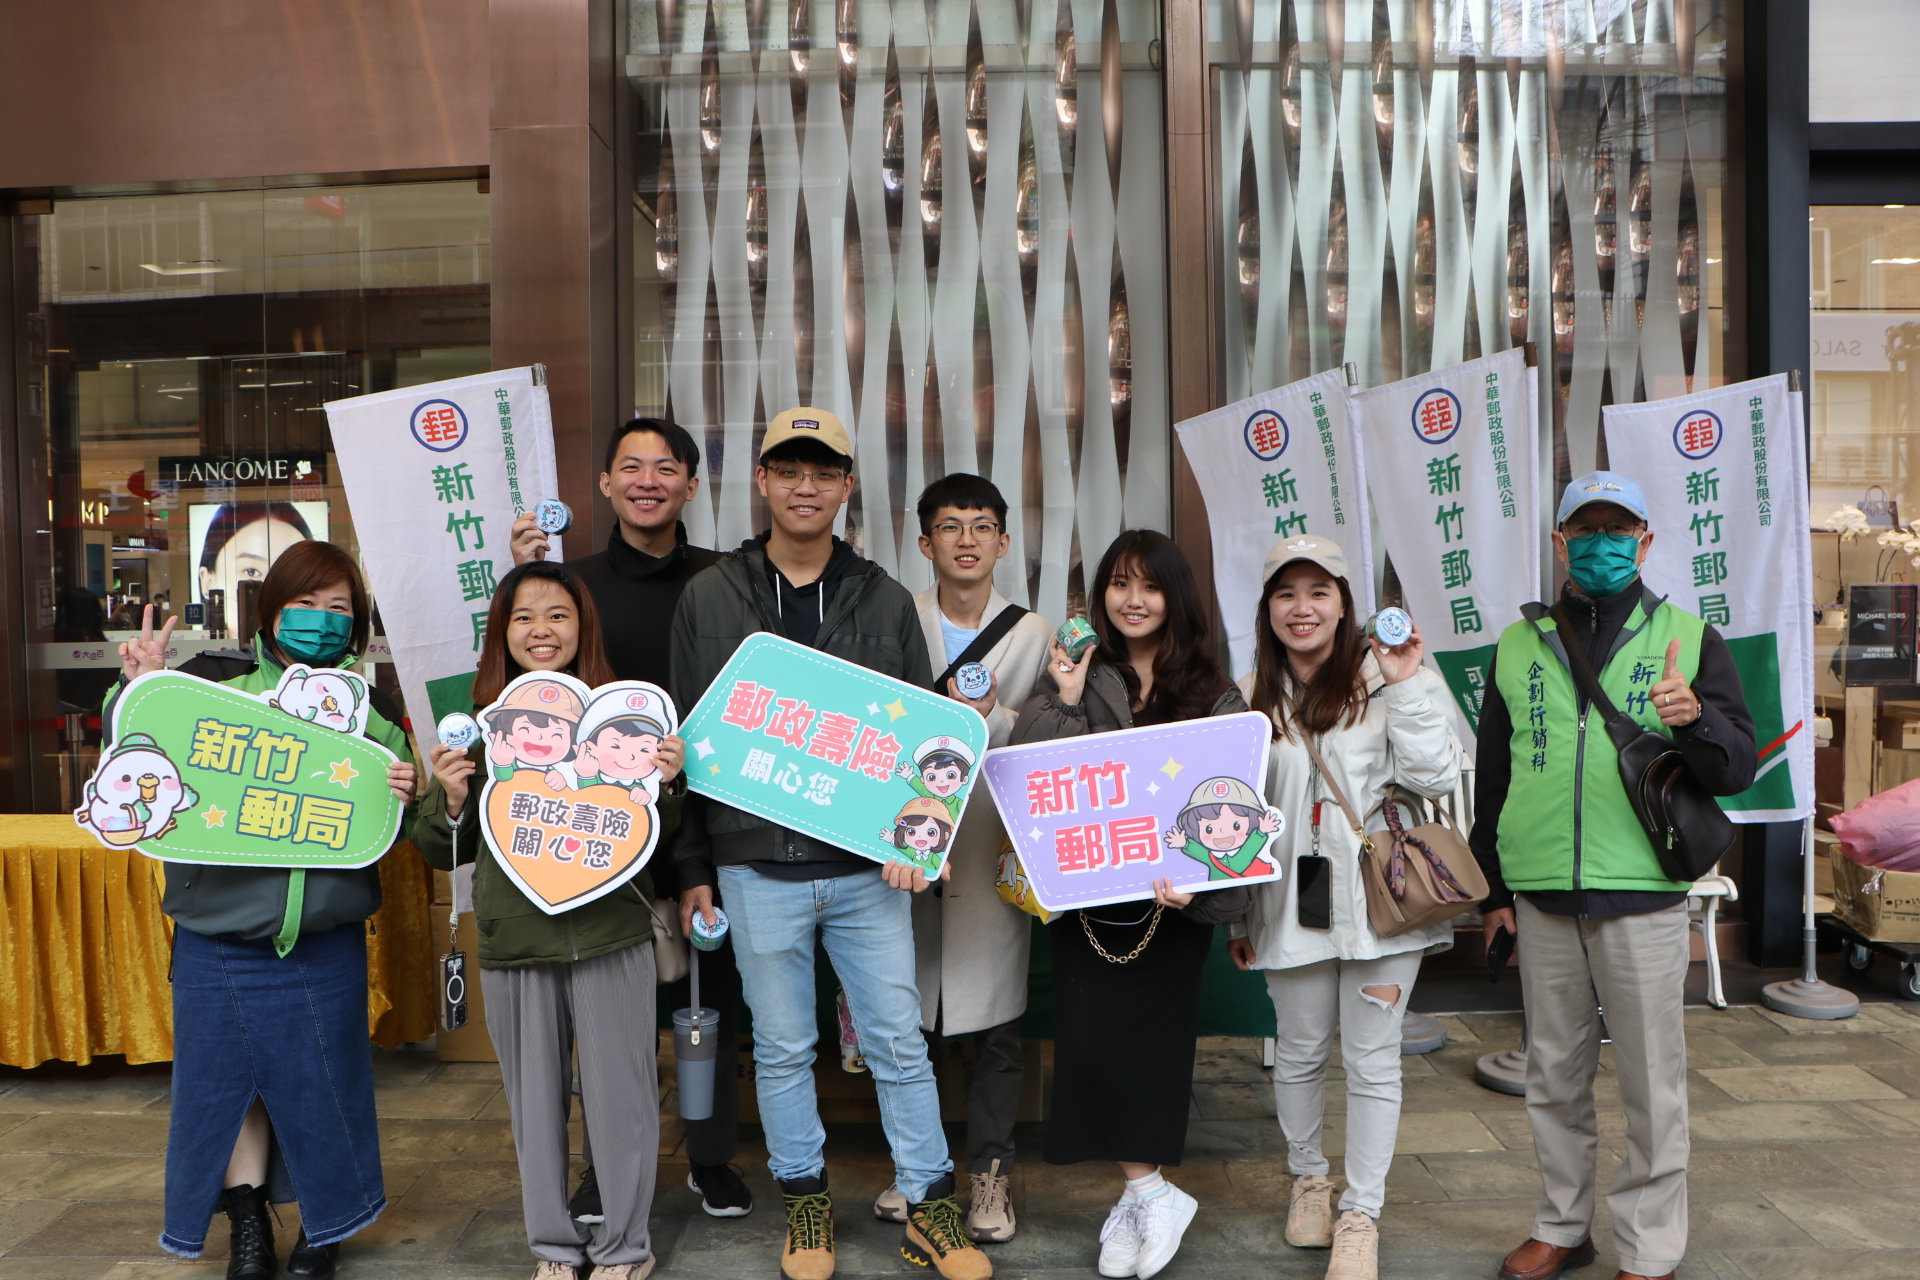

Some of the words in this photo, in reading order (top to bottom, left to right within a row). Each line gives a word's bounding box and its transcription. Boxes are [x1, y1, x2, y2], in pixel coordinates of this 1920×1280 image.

[174, 457, 288, 482] LANCÔME
[494, 387, 526, 518] 中華郵政股份有限公
[1309, 391, 1345, 525] 中華郵政股份有限公司
[1485, 371, 1516, 518] 中華郵政股份有限公司
[1749, 396, 1771, 526] 中華郵政股份有限公司
[1426, 452, 1483, 635] 新竹郵局
[1686, 466, 1730, 627] 新竹郵局
[1527, 660, 1547, 773] 企劃行銷科
[1625, 661, 1656, 731] 新竹
[187, 717, 308, 784] 新竹
[721, 680, 903, 783] 郵政壽險
[739, 748, 840, 807] 關心您
[1025, 759, 1129, 816] 新竹
[236, 785, 354, 850] 郵局
[510, 792, 632, 839] 郵政壽險
[511, 826, 614, 868] 關心您
[1054, 815, 1162, 874] 郵局
